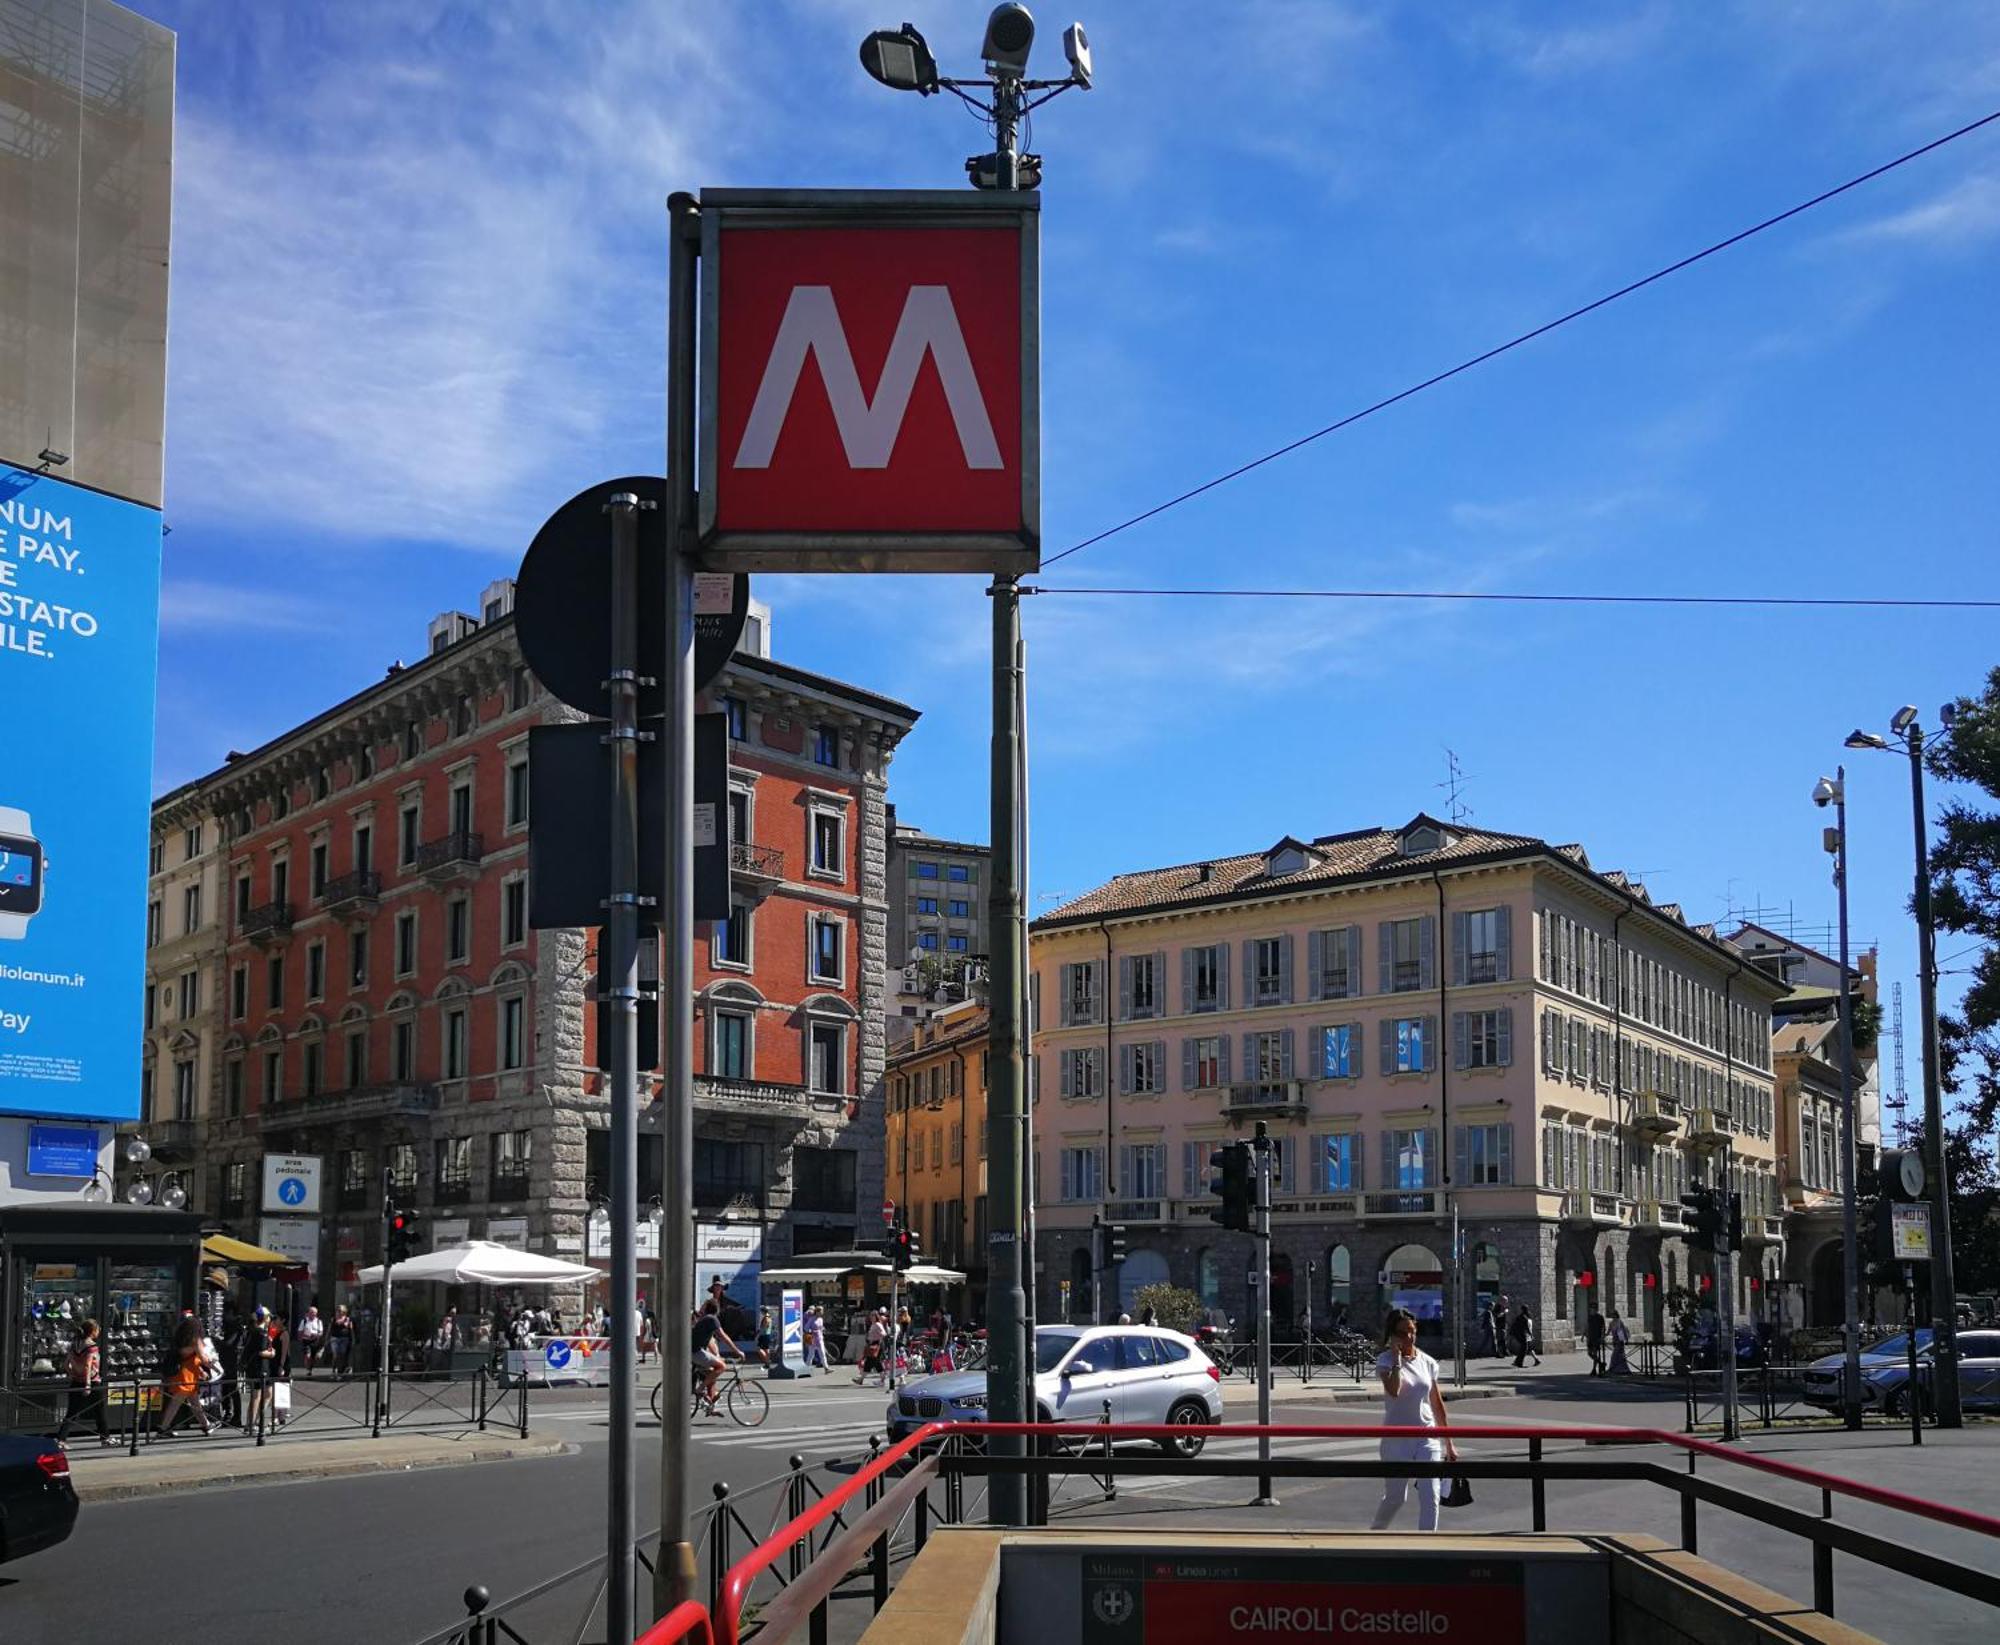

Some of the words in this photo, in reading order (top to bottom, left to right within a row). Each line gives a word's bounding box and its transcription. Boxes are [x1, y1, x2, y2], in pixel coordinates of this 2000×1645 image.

[733, 285, 1004, 470] M
[19, 535, 85, 575] PAY.
[0, 591, 97, 637] STATO
[1090, 1563, 1135, 1576] Milano
[1229, 1605, 1334, 1632] CAIROLI
[1340, 1606, 1450, 1634] Castello
